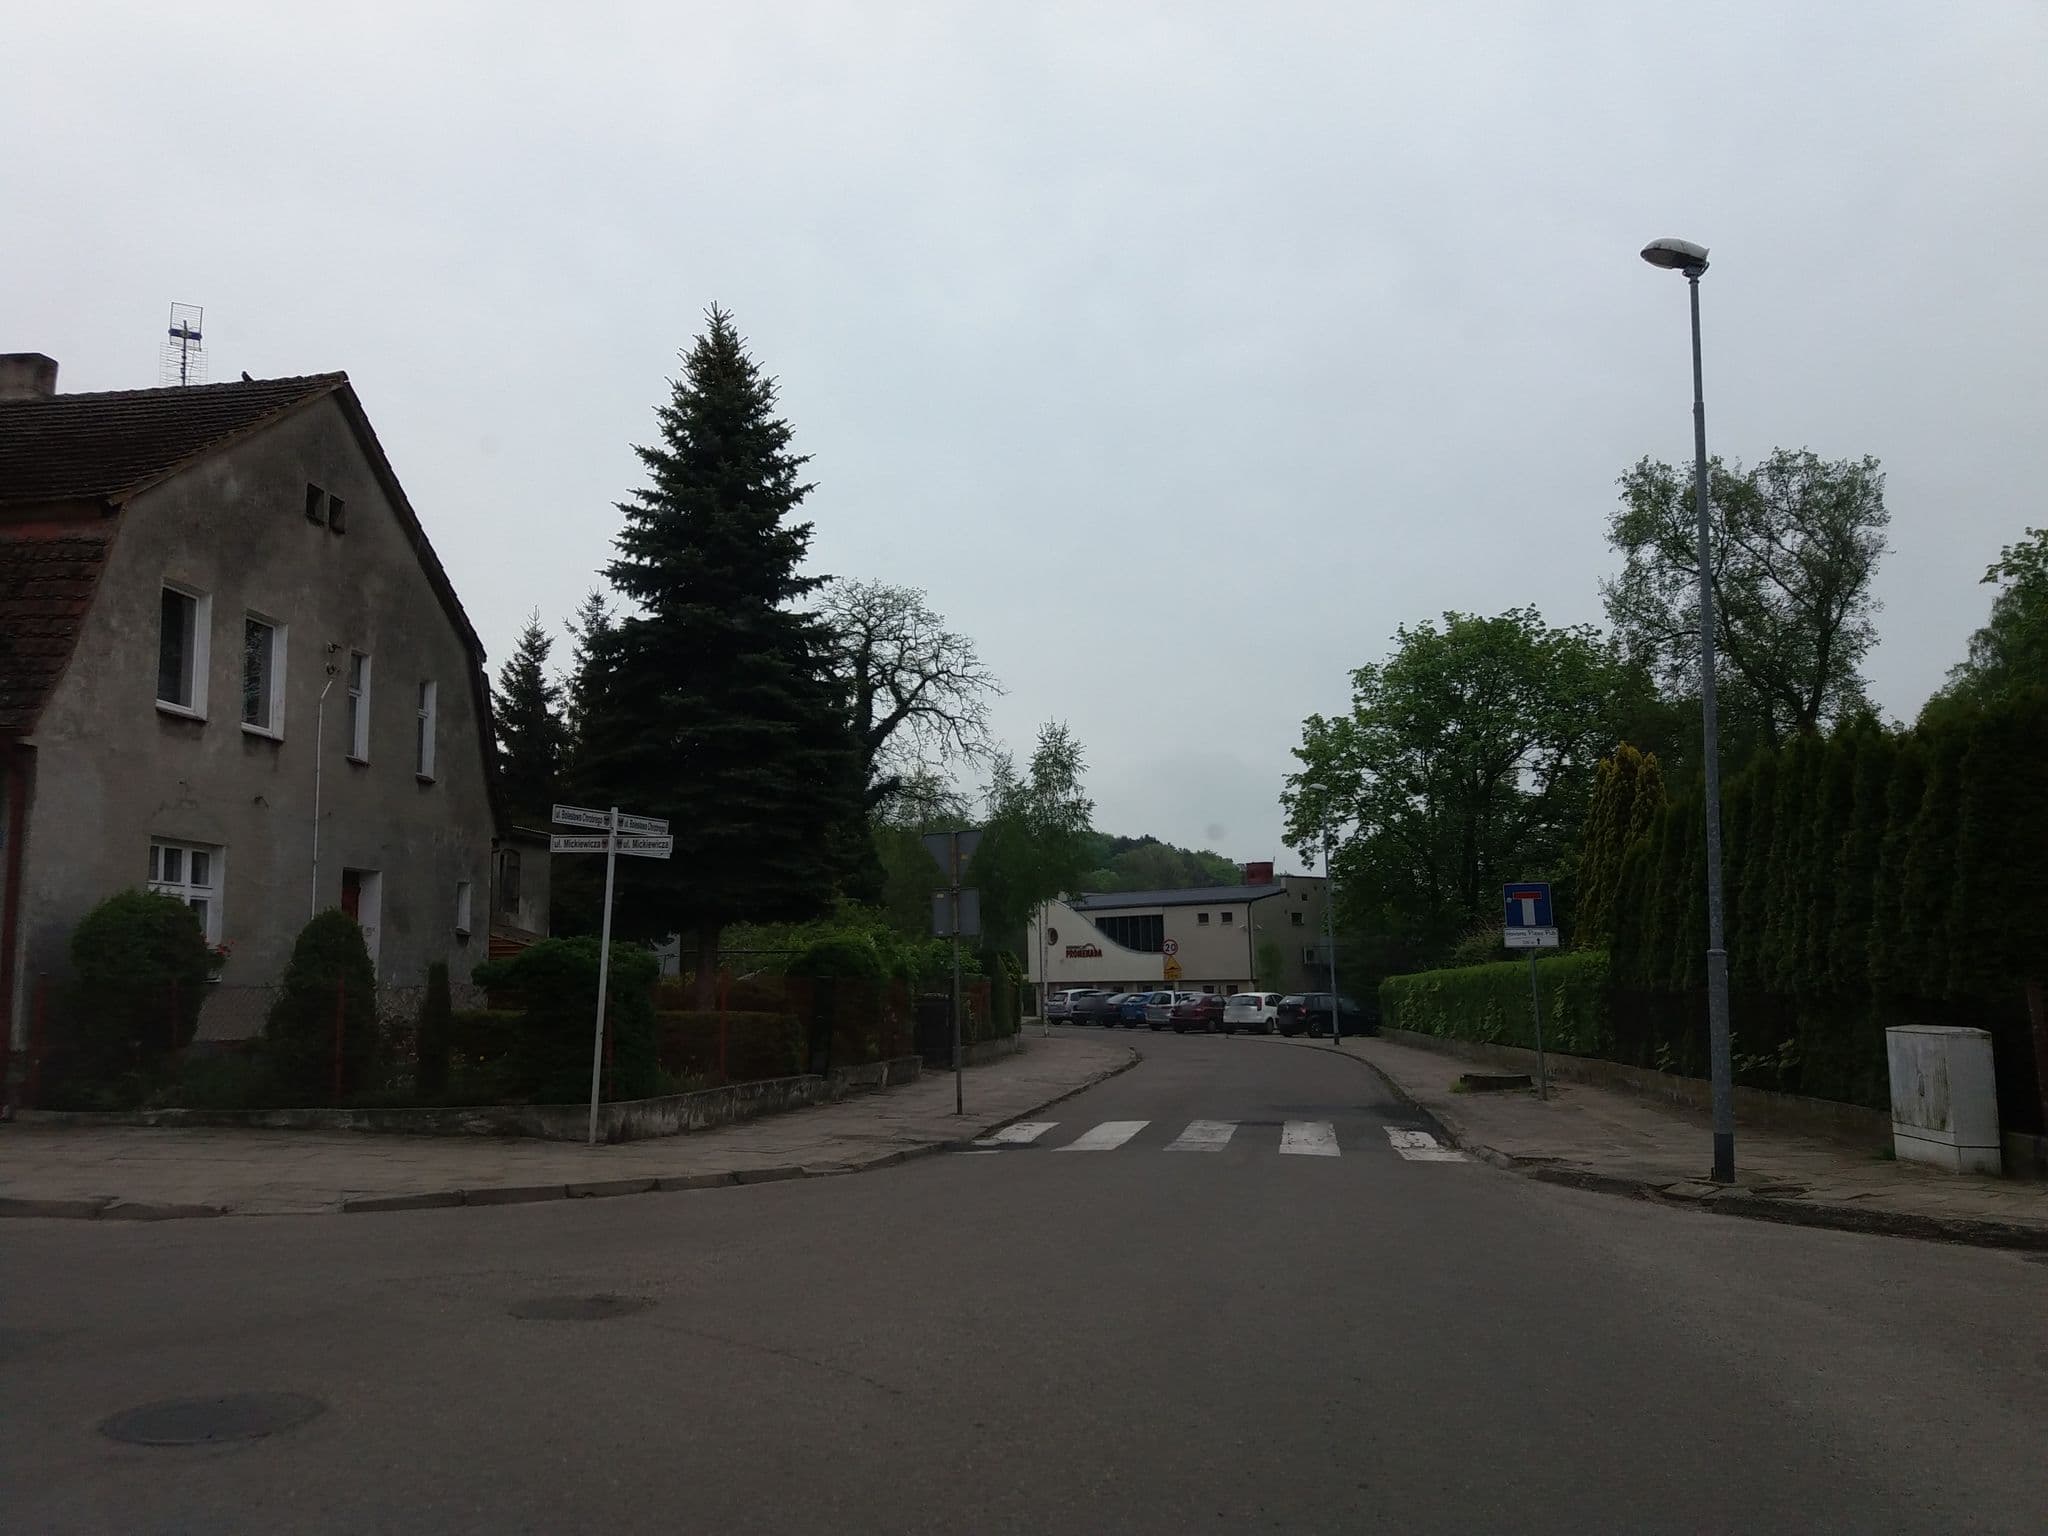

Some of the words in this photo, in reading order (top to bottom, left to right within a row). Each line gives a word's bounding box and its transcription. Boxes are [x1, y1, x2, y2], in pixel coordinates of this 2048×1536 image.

[582, 813, 603, 826] Chrobrego
[554, 839, 562, 848] ul.
[563, 839, 601, 848] Mickiewicza
[632, 839, 669, 848] Mickiewicza
[1165, 943, 1177, 952] 20
[1066, 949, 1102, 959] PROMENADA
